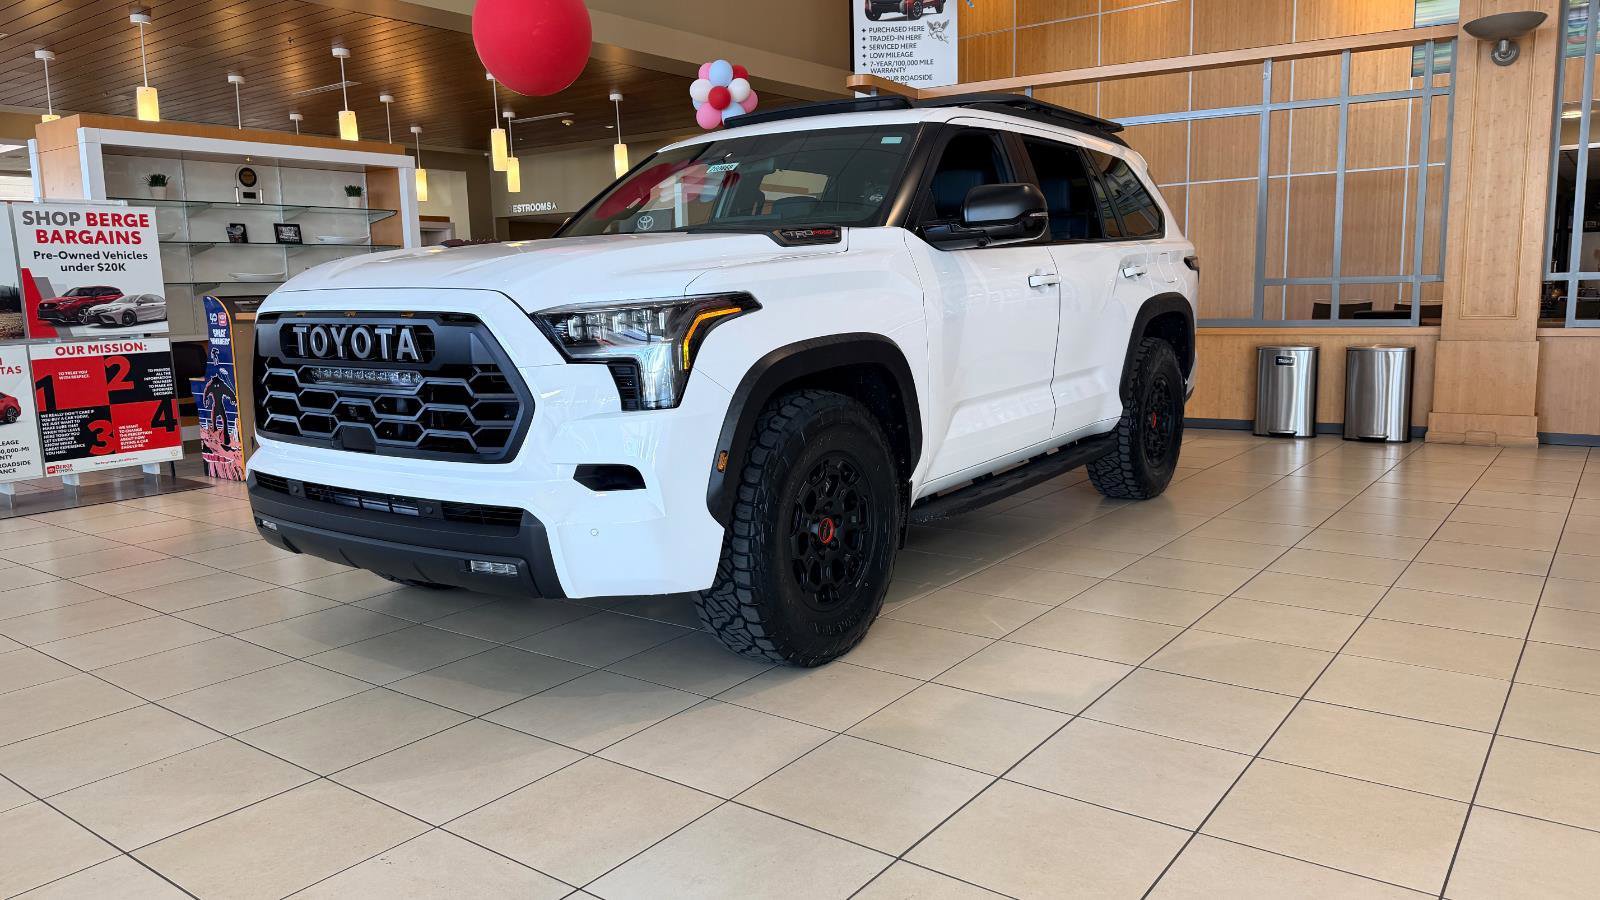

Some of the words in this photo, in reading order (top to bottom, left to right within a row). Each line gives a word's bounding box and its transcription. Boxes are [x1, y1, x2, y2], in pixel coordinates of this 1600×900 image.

[22, 210, 80, 226] SHOP
[86, 212, 150, 228] BERGE
[36, 229, 142, 244] BARGAINS
[33, 251, 100, 260] Pre-Owned
[103, 251, 148, 260] Vehicles
[60, 263, 95, 272] under
[97, 262, 126, 272] $20K
[55, 345, 85, 357] OUR
[88, 342, 148, 354] MISSION:
[292, 326, 420, 360] TOYOTA
[105, 355, 134, 392] 2
[35, 375, 58, 412] 1
[151, 399, 178, 432] 4
[88, 419, 114, 455] 3
